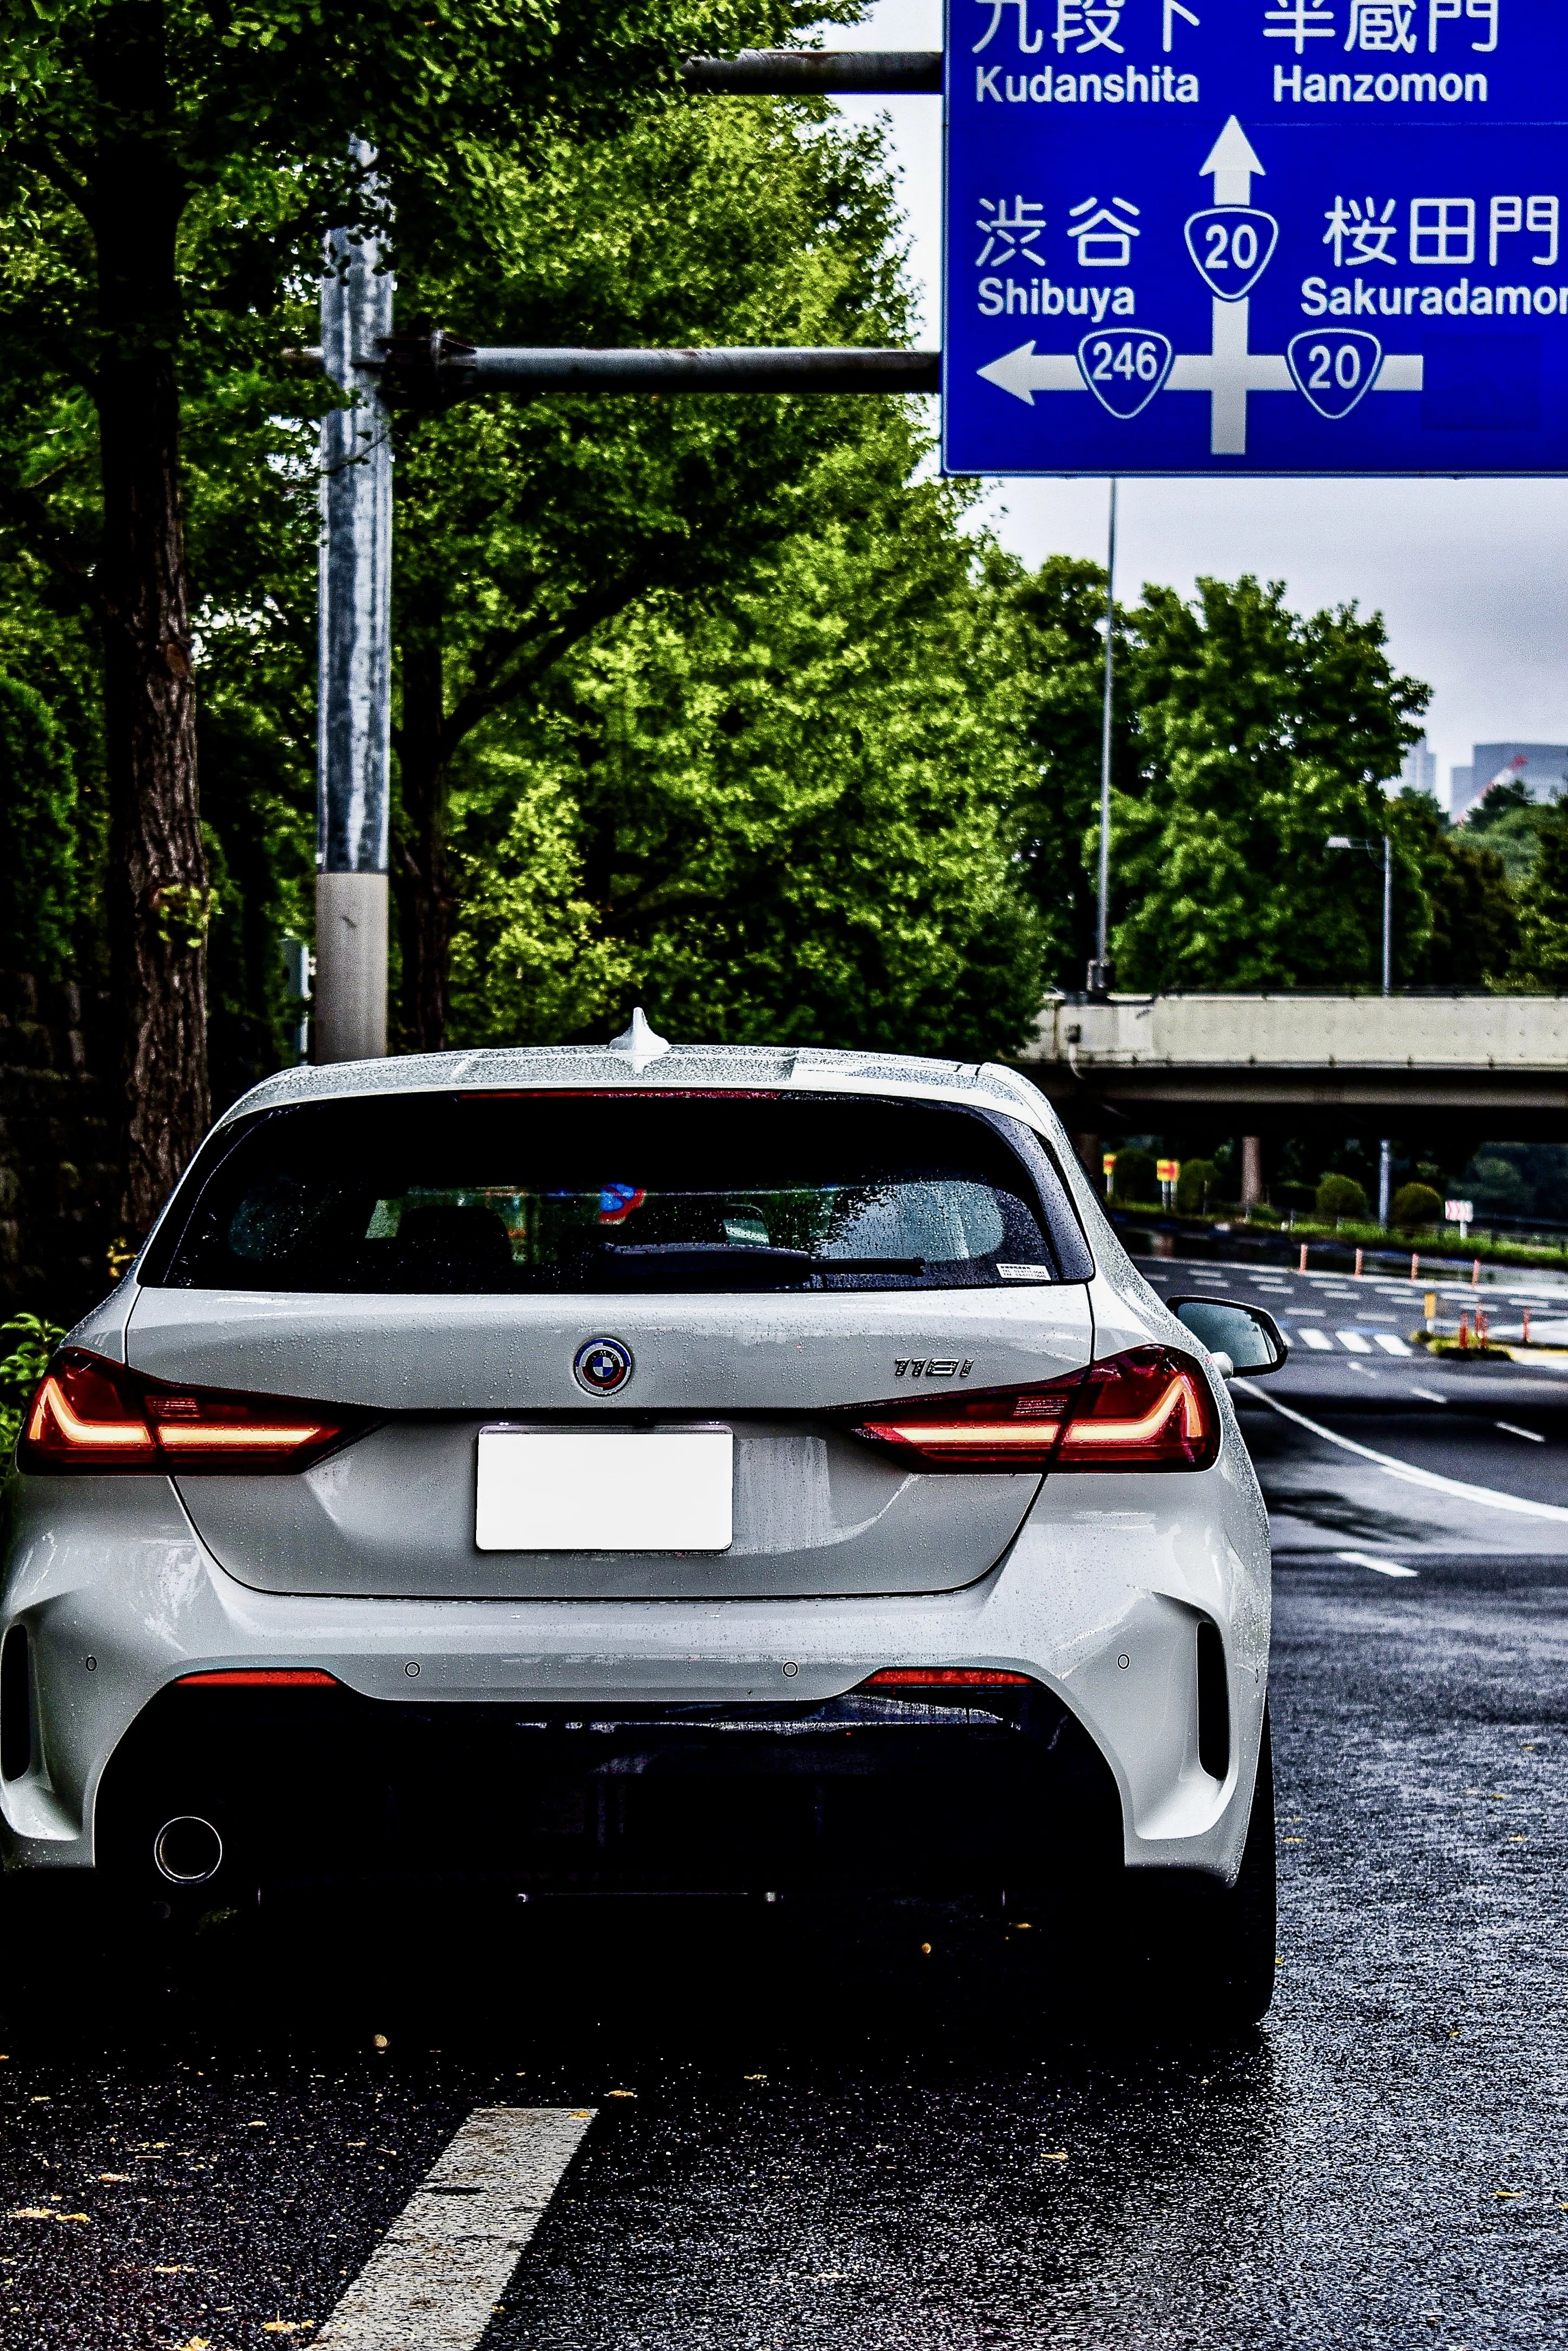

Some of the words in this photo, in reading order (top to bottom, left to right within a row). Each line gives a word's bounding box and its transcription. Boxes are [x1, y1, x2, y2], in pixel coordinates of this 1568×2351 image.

[972, 0, 1201, 54] 九段下
[1262, 0, 1499, 55] 半蔵門
[976, 65, 1200, 103] Kudanshita
[1273, 64, 1488, 102] Hanzomon
[975, 195, 1140, 267] 渋谷
[1205, 224, 1258, 270] 20
[1322, 195, 1559, 267] 桜田門
[978, 278, 1135, 323] Shibuya
[1092, 341, 1158, 381] 246
[1308, 345, 1361, 389] 20
